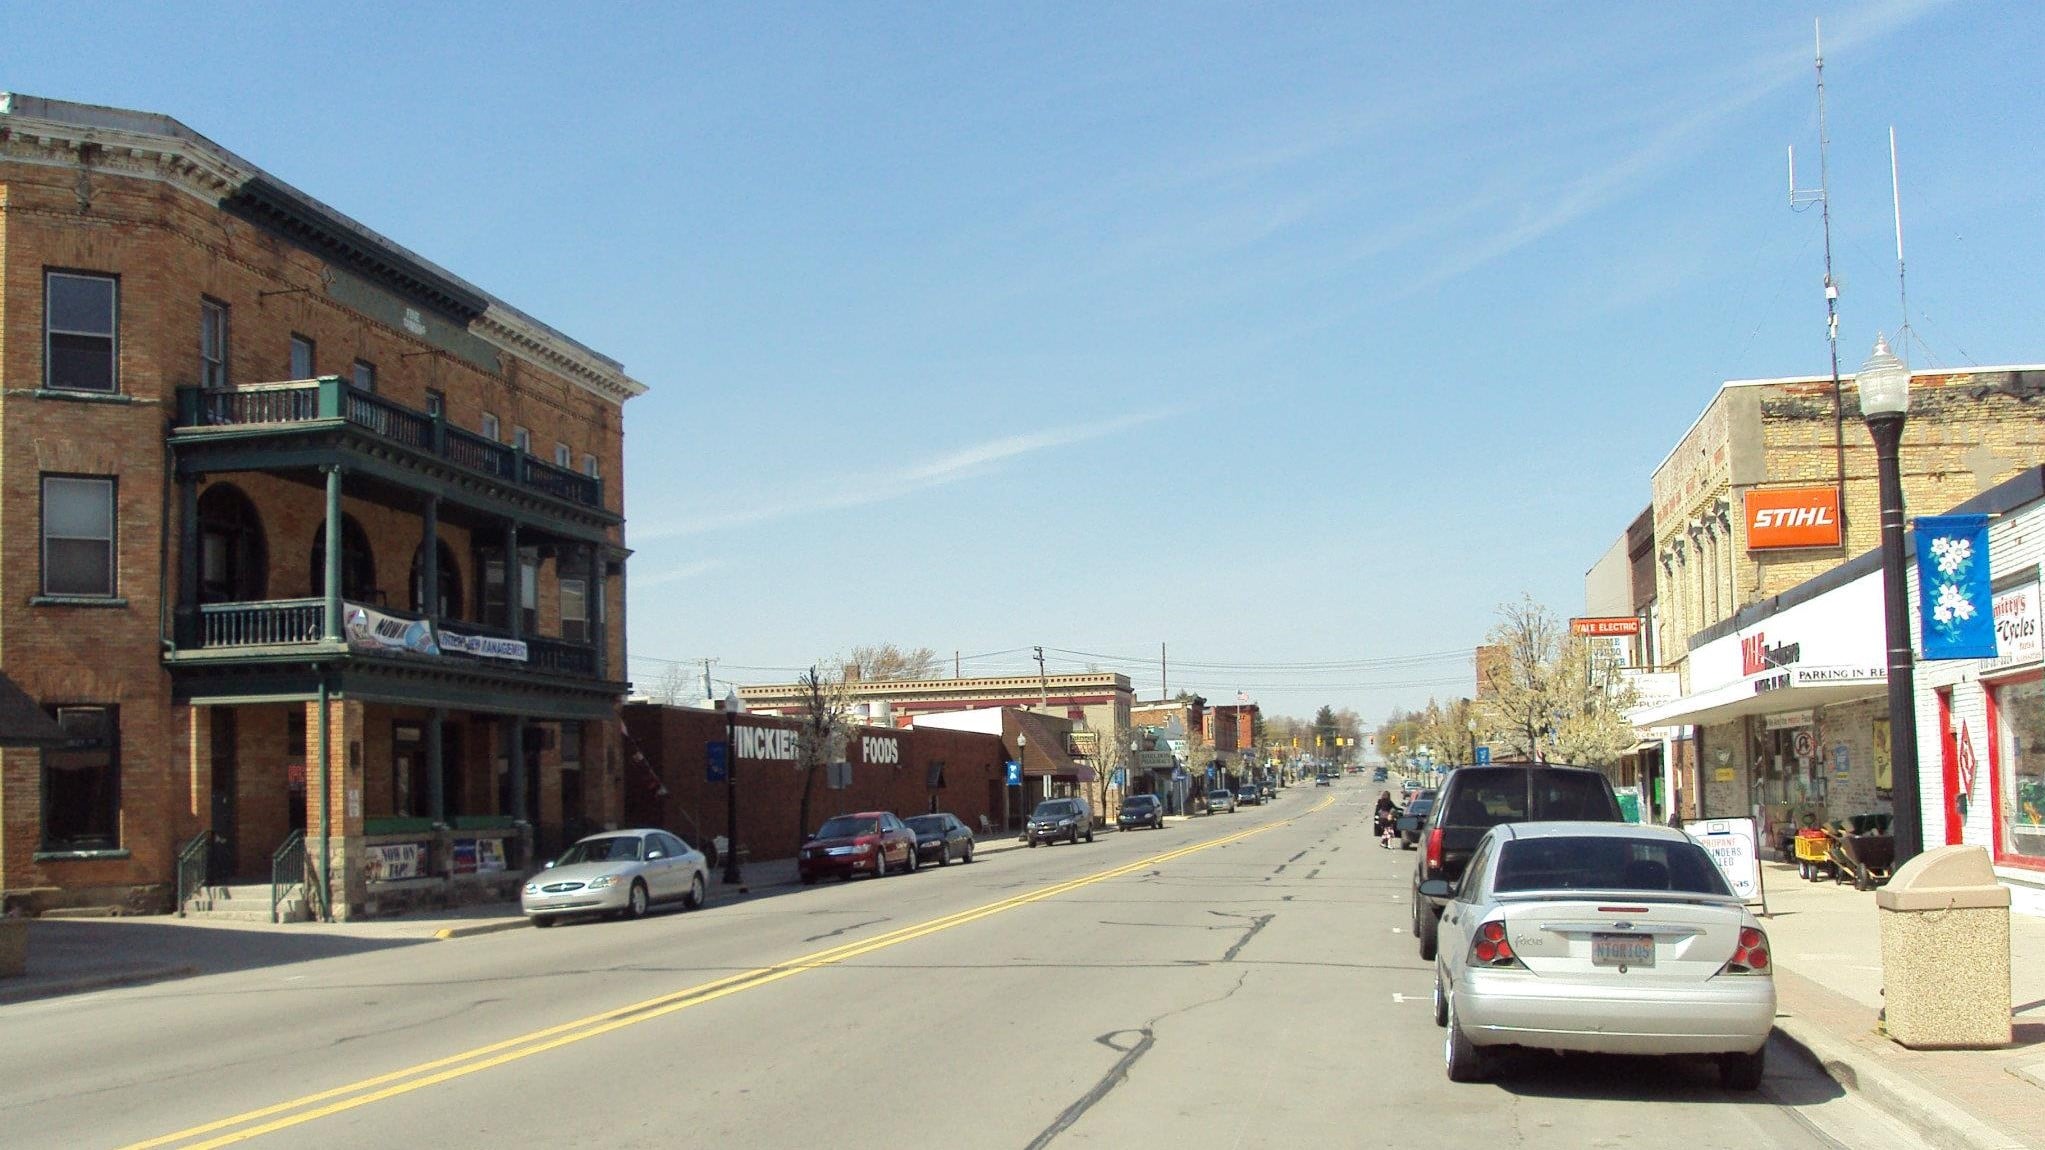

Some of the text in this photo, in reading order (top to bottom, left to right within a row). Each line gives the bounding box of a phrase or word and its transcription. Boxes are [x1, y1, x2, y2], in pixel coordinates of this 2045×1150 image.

[1753, 506, 1834, 528] STIHL
[1994, 596, 2025, 616] mitty's
[1599, 622, 1637, 632] ELECTRIC
[1799, 667, 1887, 680] PARKING IN RE
[862, 735, 899, 764] FOODS
